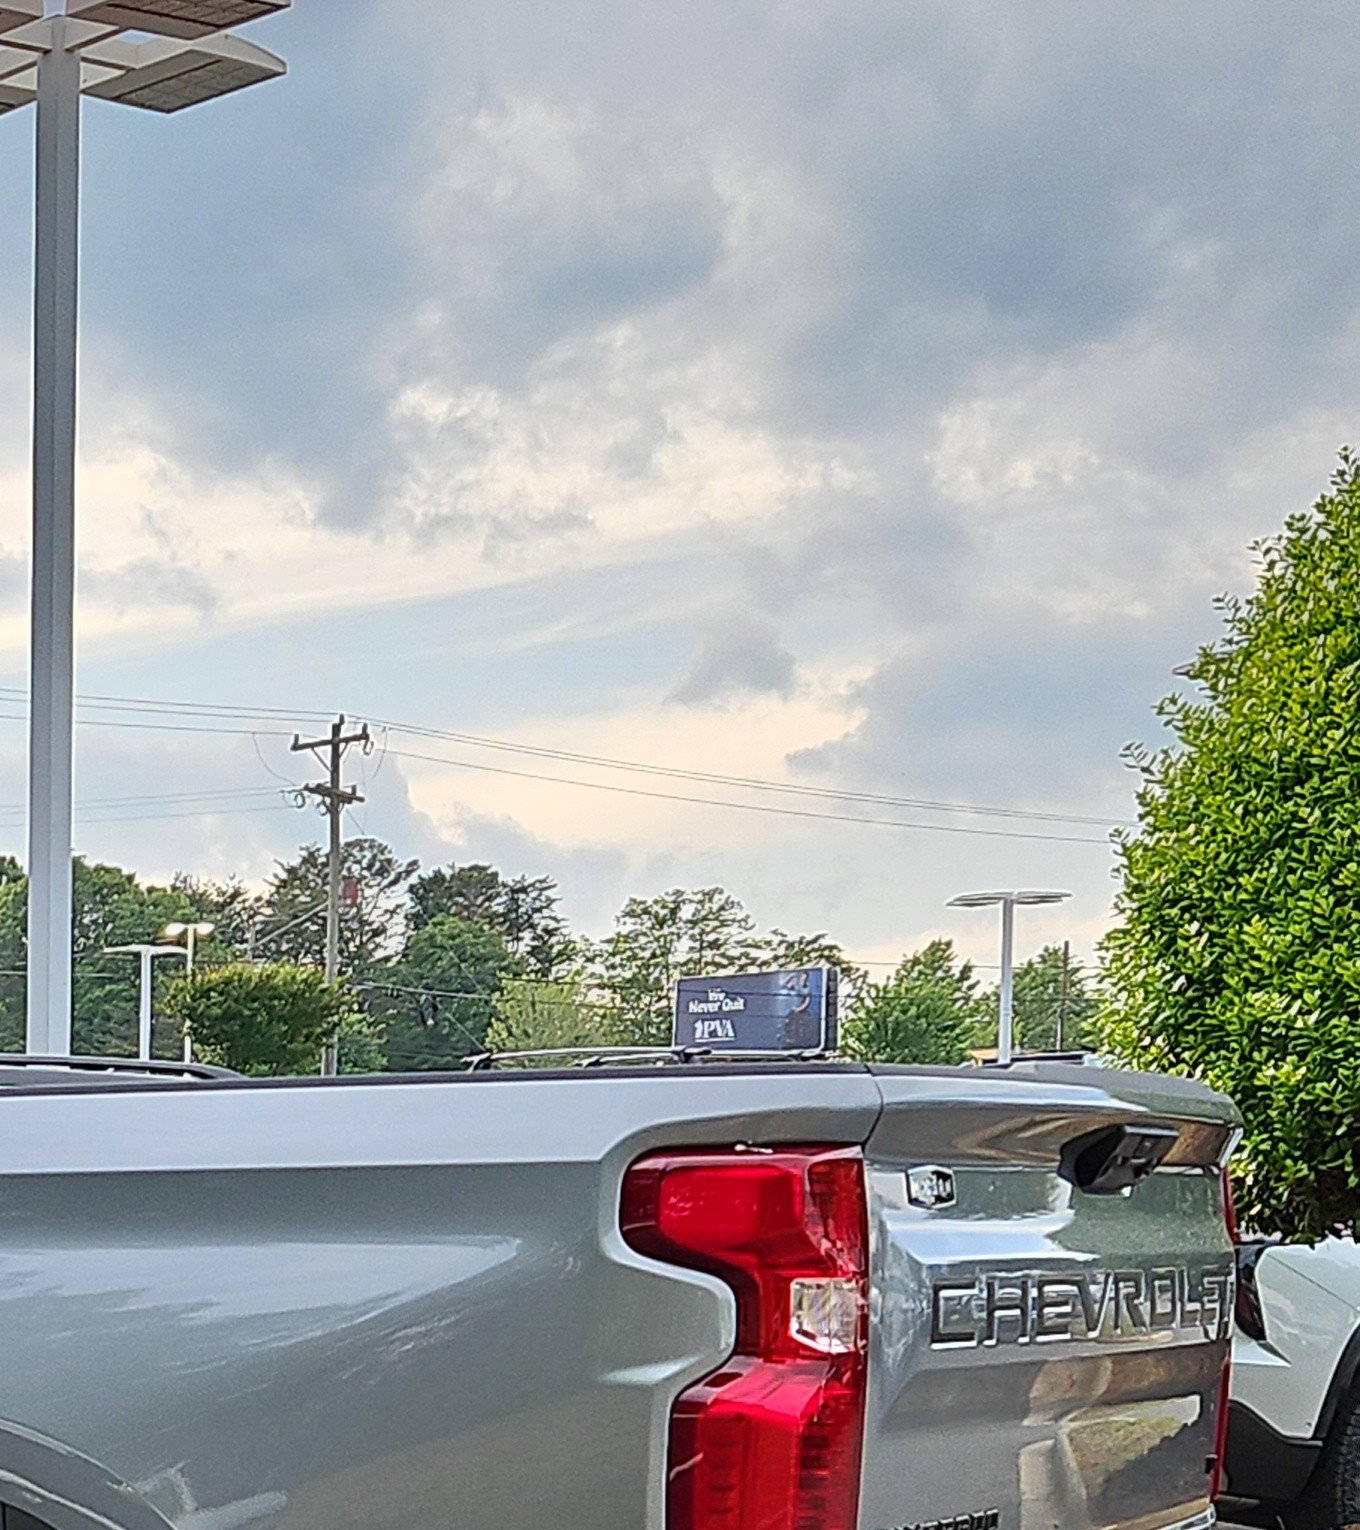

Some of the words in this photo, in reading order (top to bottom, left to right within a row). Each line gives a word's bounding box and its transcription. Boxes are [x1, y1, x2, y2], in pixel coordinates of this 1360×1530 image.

[688, 1000, 720, 1013] Never
[722, 997, 745, 1011] Quit
[930, 1266, 1236, 1350] CHEVROLET
